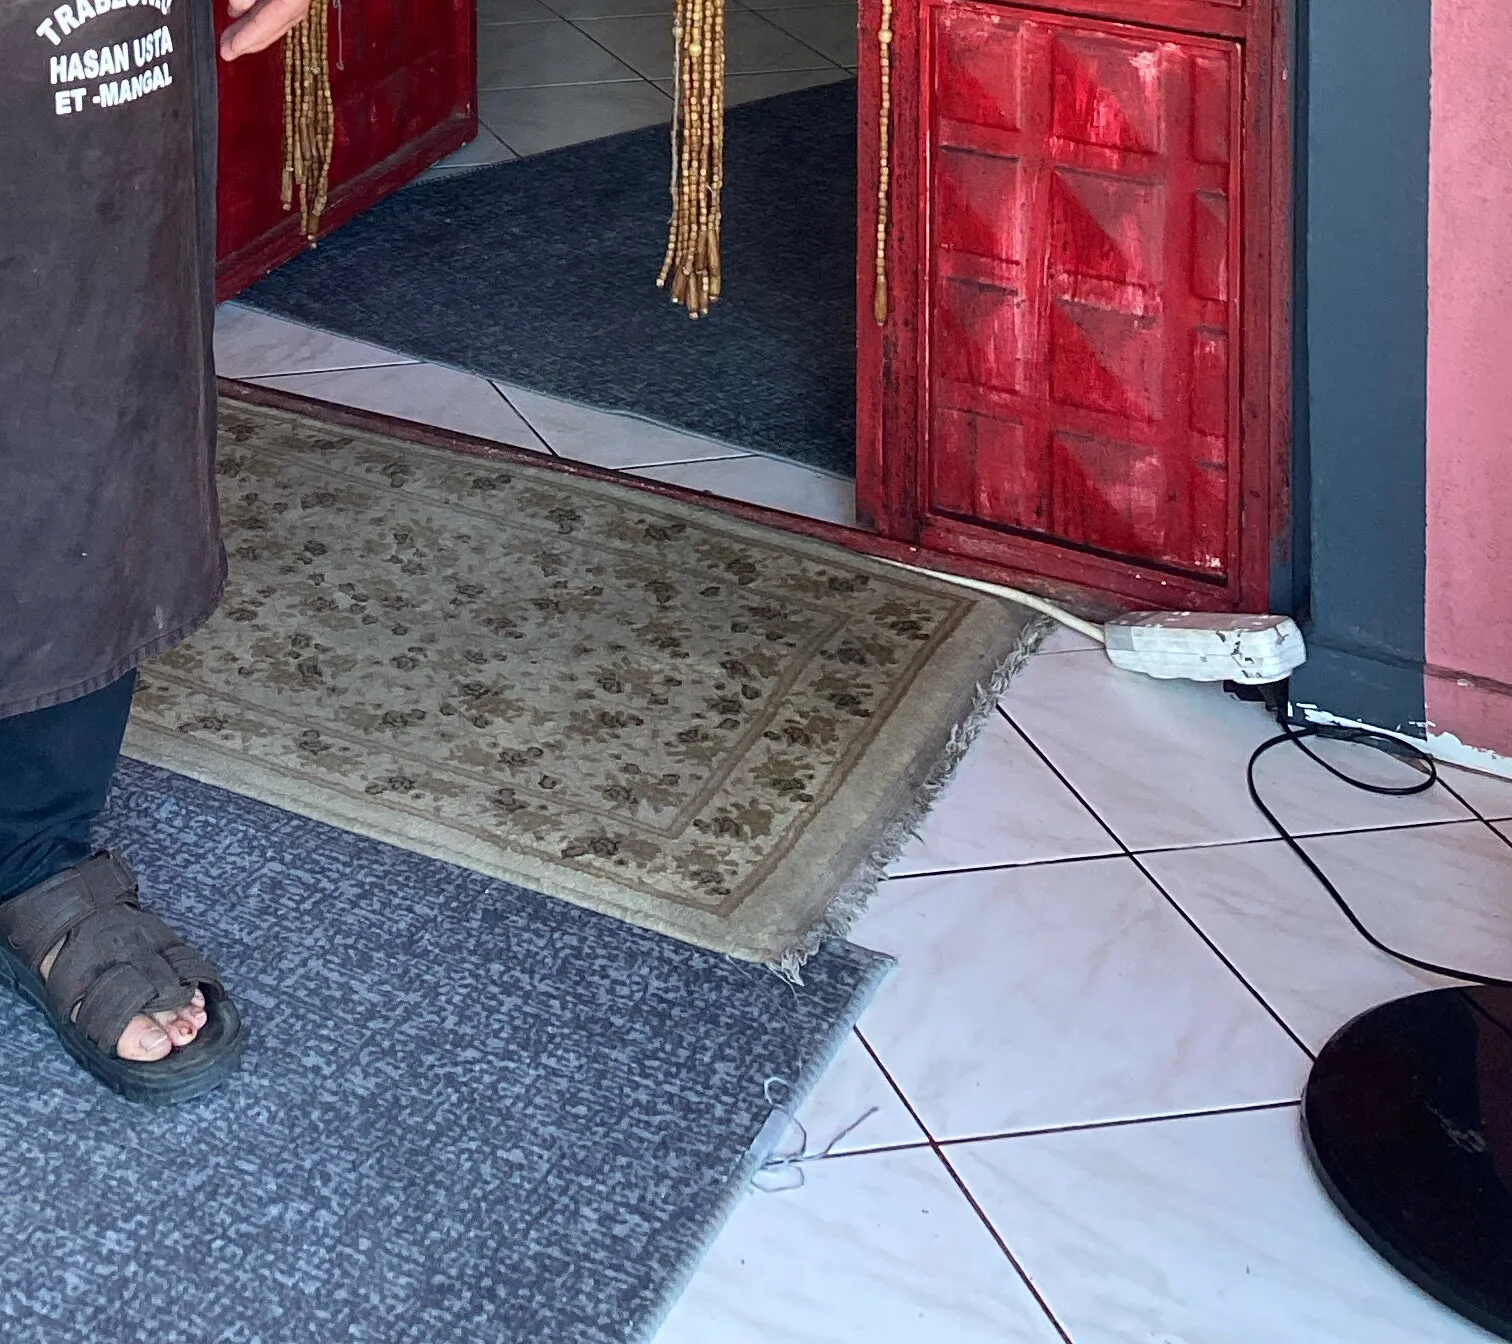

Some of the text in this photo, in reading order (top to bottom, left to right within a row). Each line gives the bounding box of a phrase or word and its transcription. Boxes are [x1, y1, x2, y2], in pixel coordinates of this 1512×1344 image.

[50, 25, 174, 85] HASAN USTA
[55, 87, 87, 115] ET
